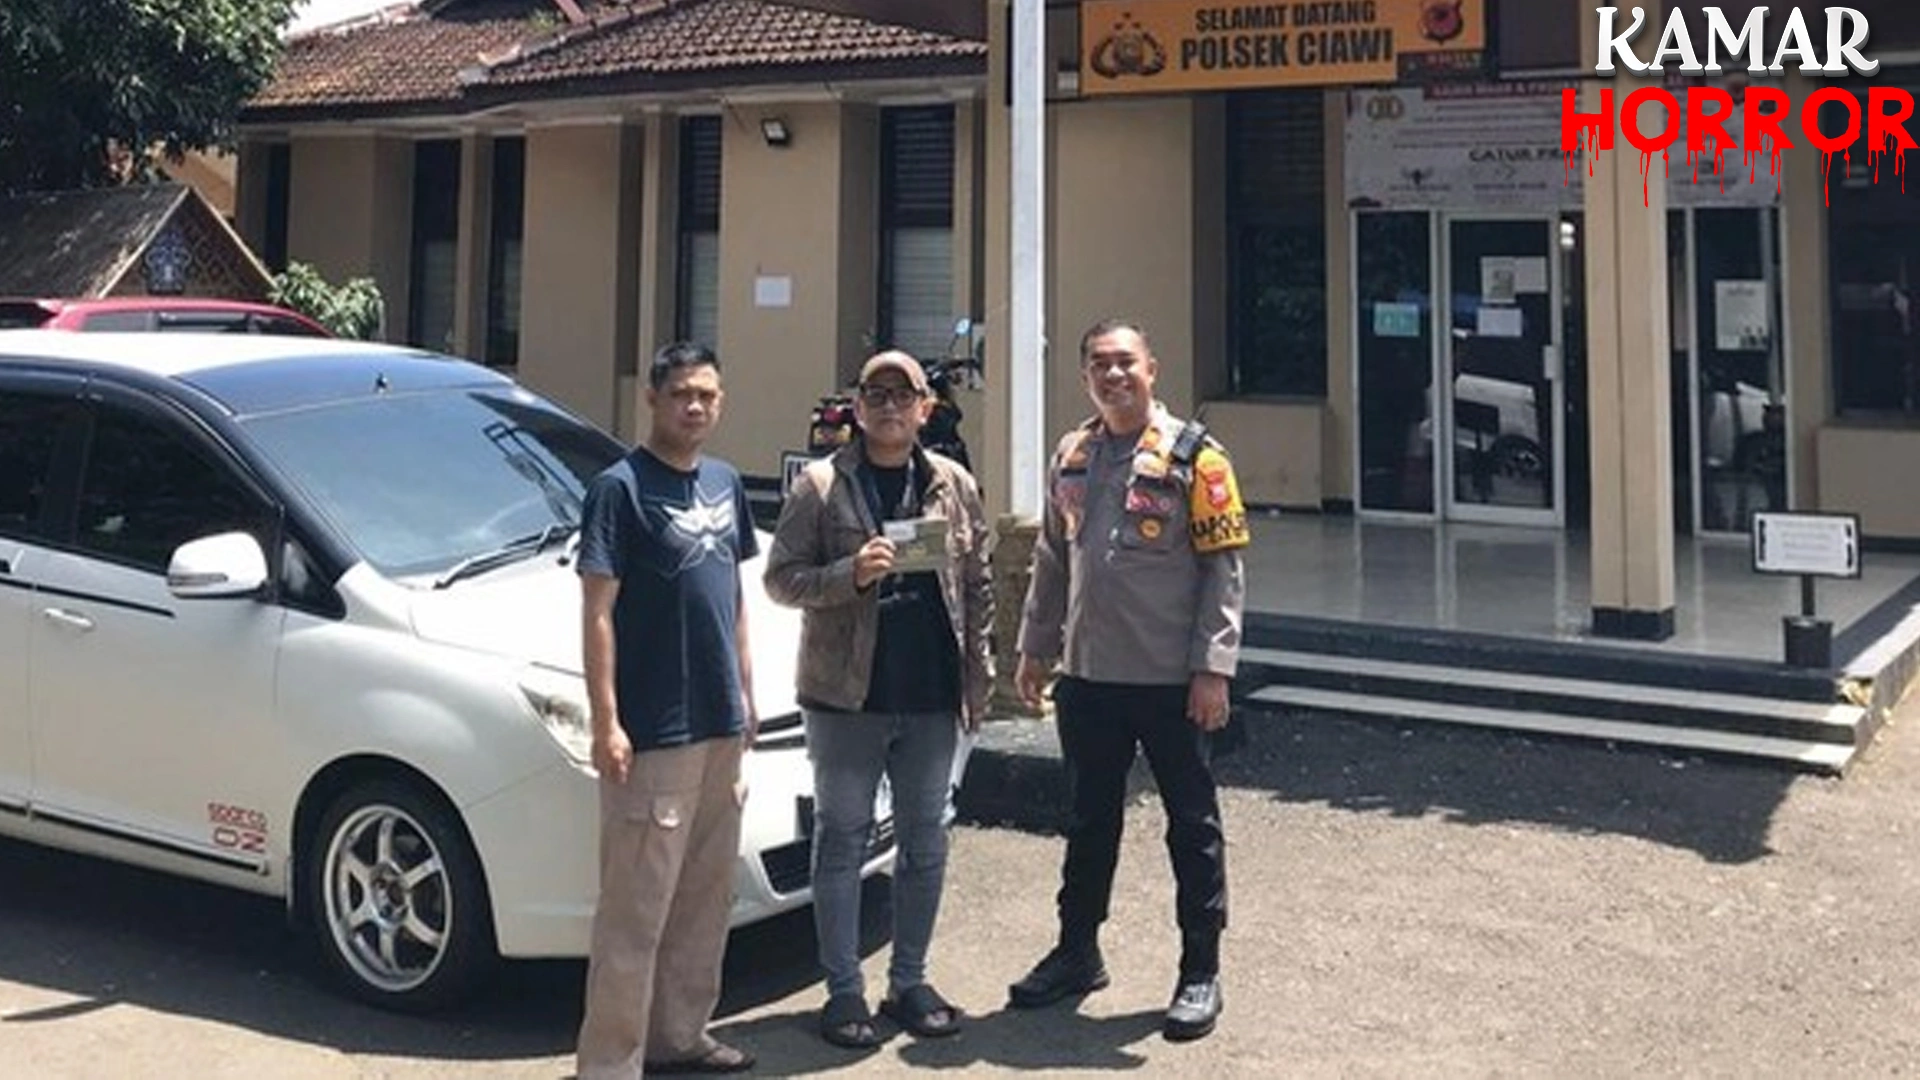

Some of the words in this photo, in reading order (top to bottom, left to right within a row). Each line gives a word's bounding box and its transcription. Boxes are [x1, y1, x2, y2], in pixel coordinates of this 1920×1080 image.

[1195, 8, 1287, 32] SELAMAT
[1292, 0, 1376, 26] DATANG
[1181, 35, 1290, 71] POLSEK
[1296, 30, 1394, 66] CIAWI
